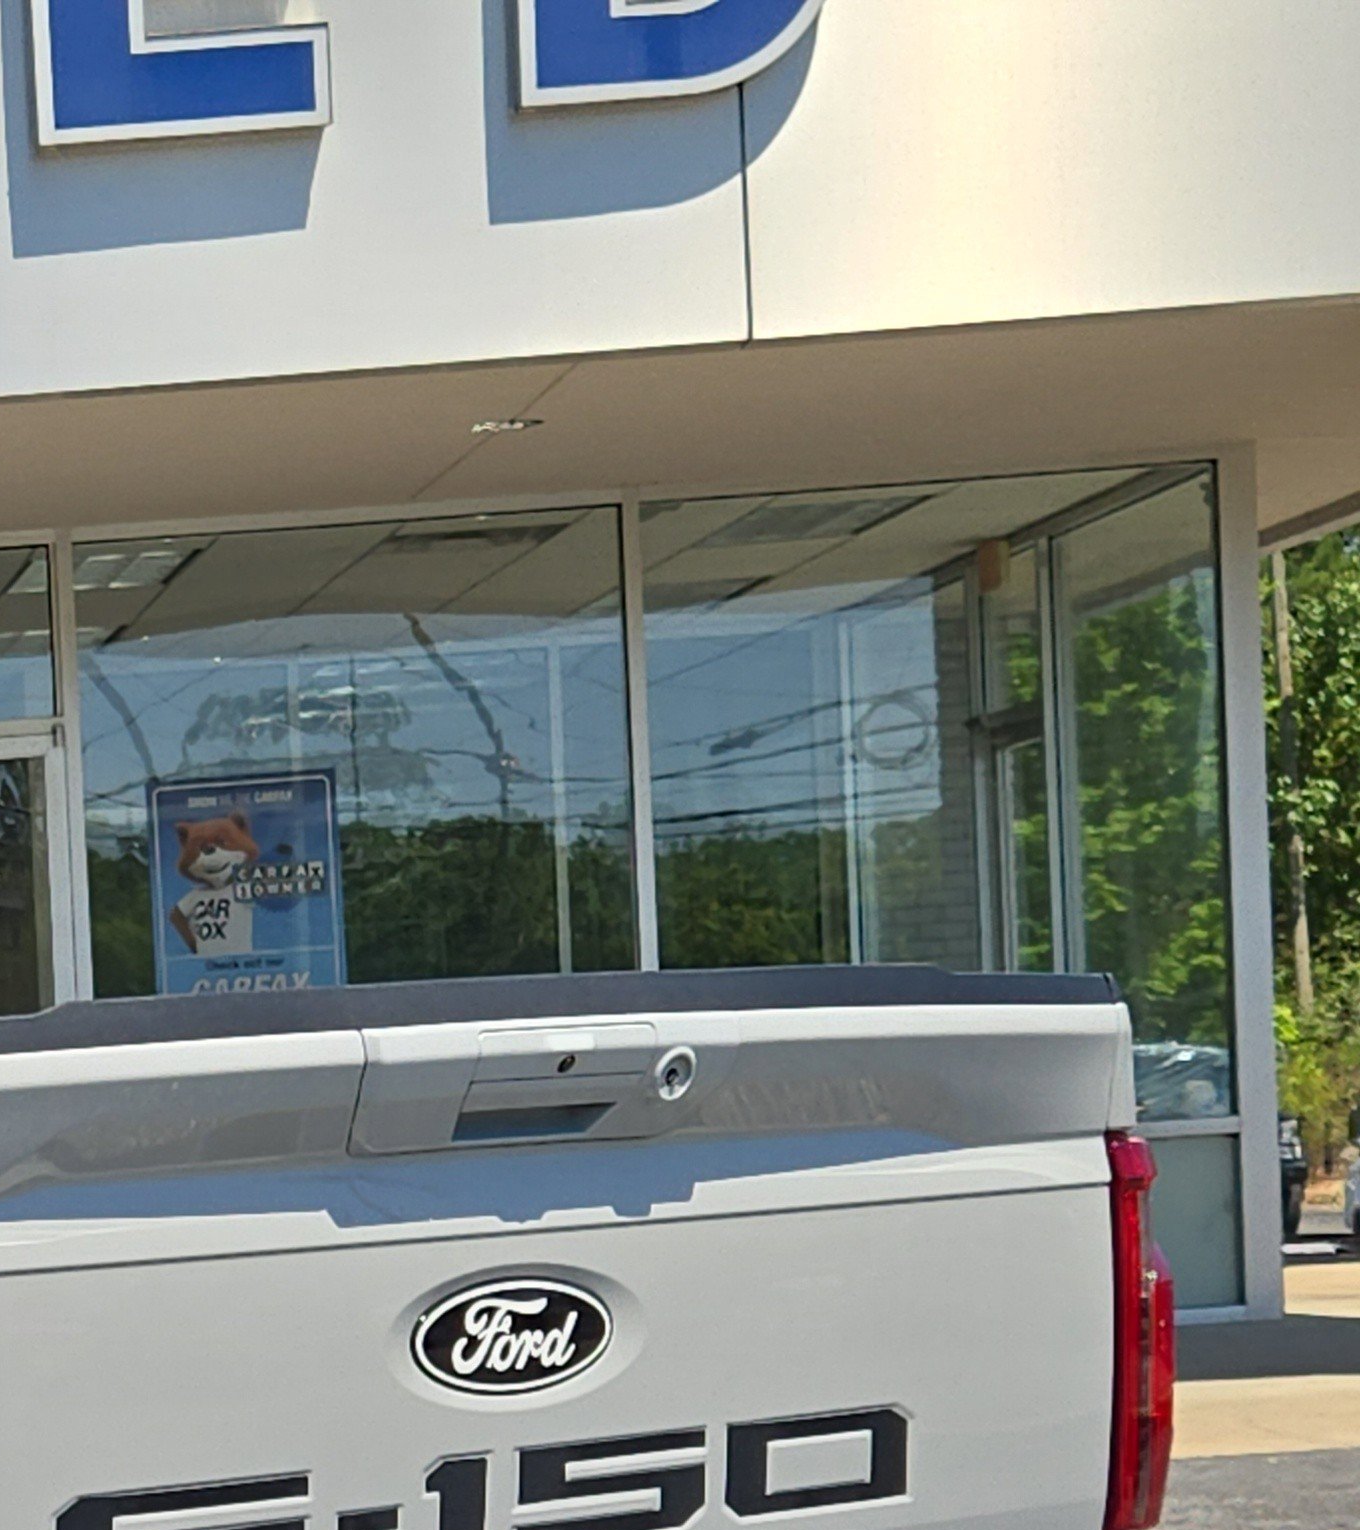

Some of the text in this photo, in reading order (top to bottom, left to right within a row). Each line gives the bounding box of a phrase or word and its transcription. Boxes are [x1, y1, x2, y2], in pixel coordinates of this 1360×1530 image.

[237, 862, 323, 880] CARFAX
[194, 898, 230, 919] CAR
[198, 922, 227, 941] OX
[451, 1297, 579, 1375] Ford
